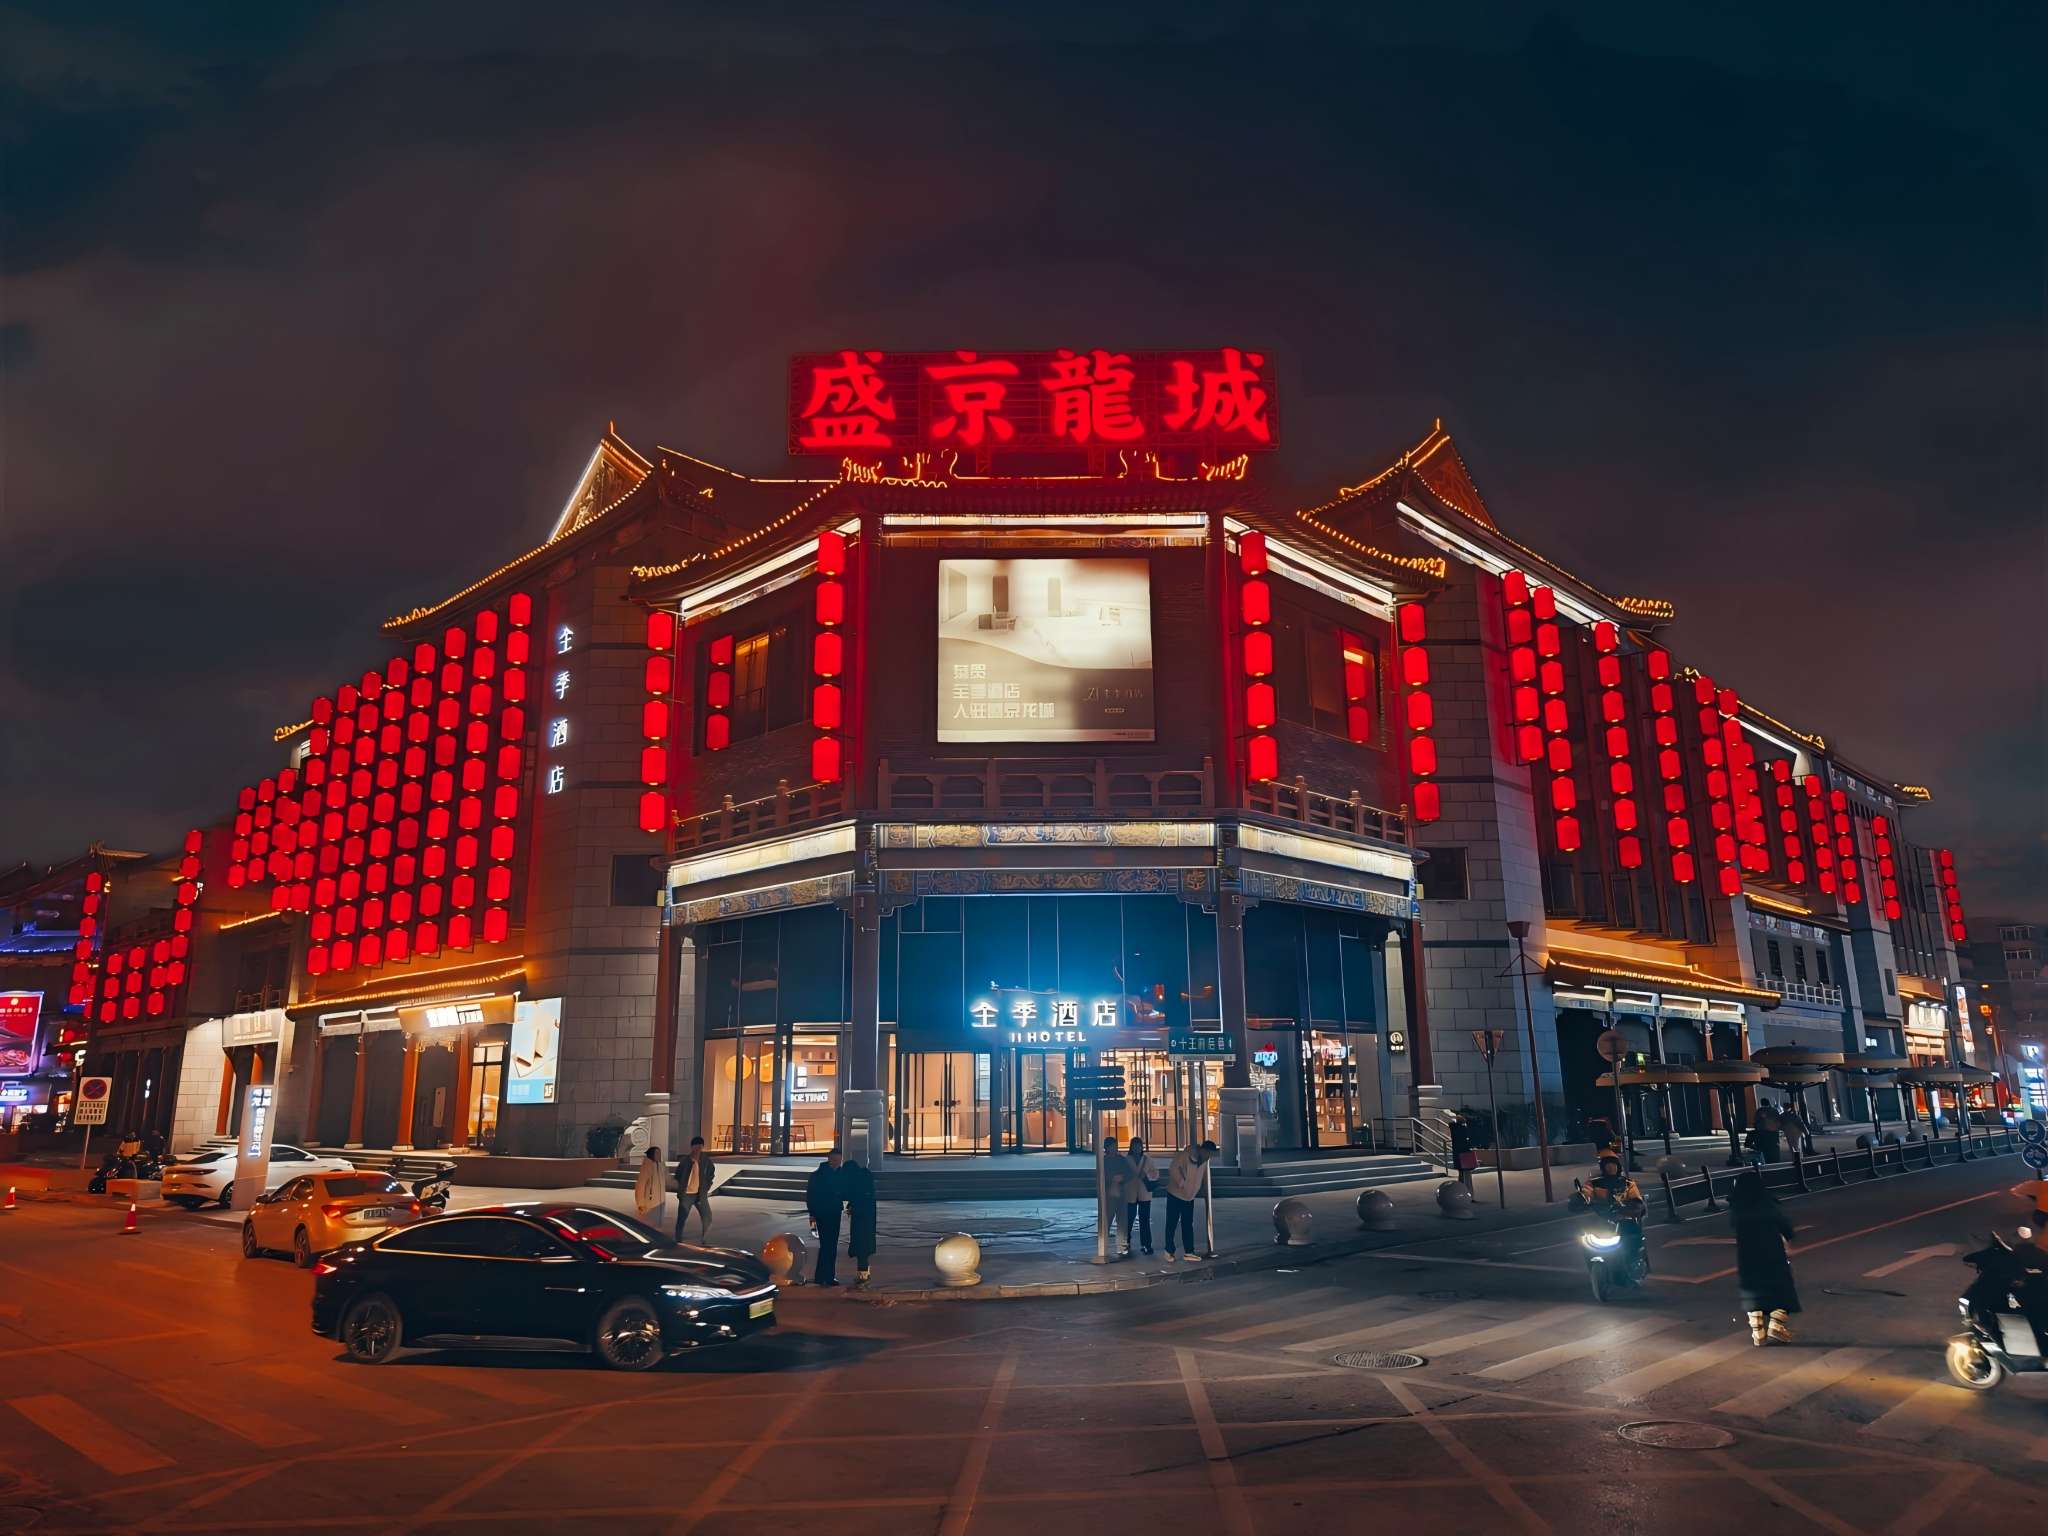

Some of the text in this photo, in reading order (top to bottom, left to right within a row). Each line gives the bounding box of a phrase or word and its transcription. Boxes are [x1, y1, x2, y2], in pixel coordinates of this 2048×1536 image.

[800, 348, 1273, 449] 盛京龍城
[548, 626, 574, 795] 全季酒店
[970, 1000, 1118, 1028] 全季酒店
[1027, 1031, 1087, 1043] HOTEL
